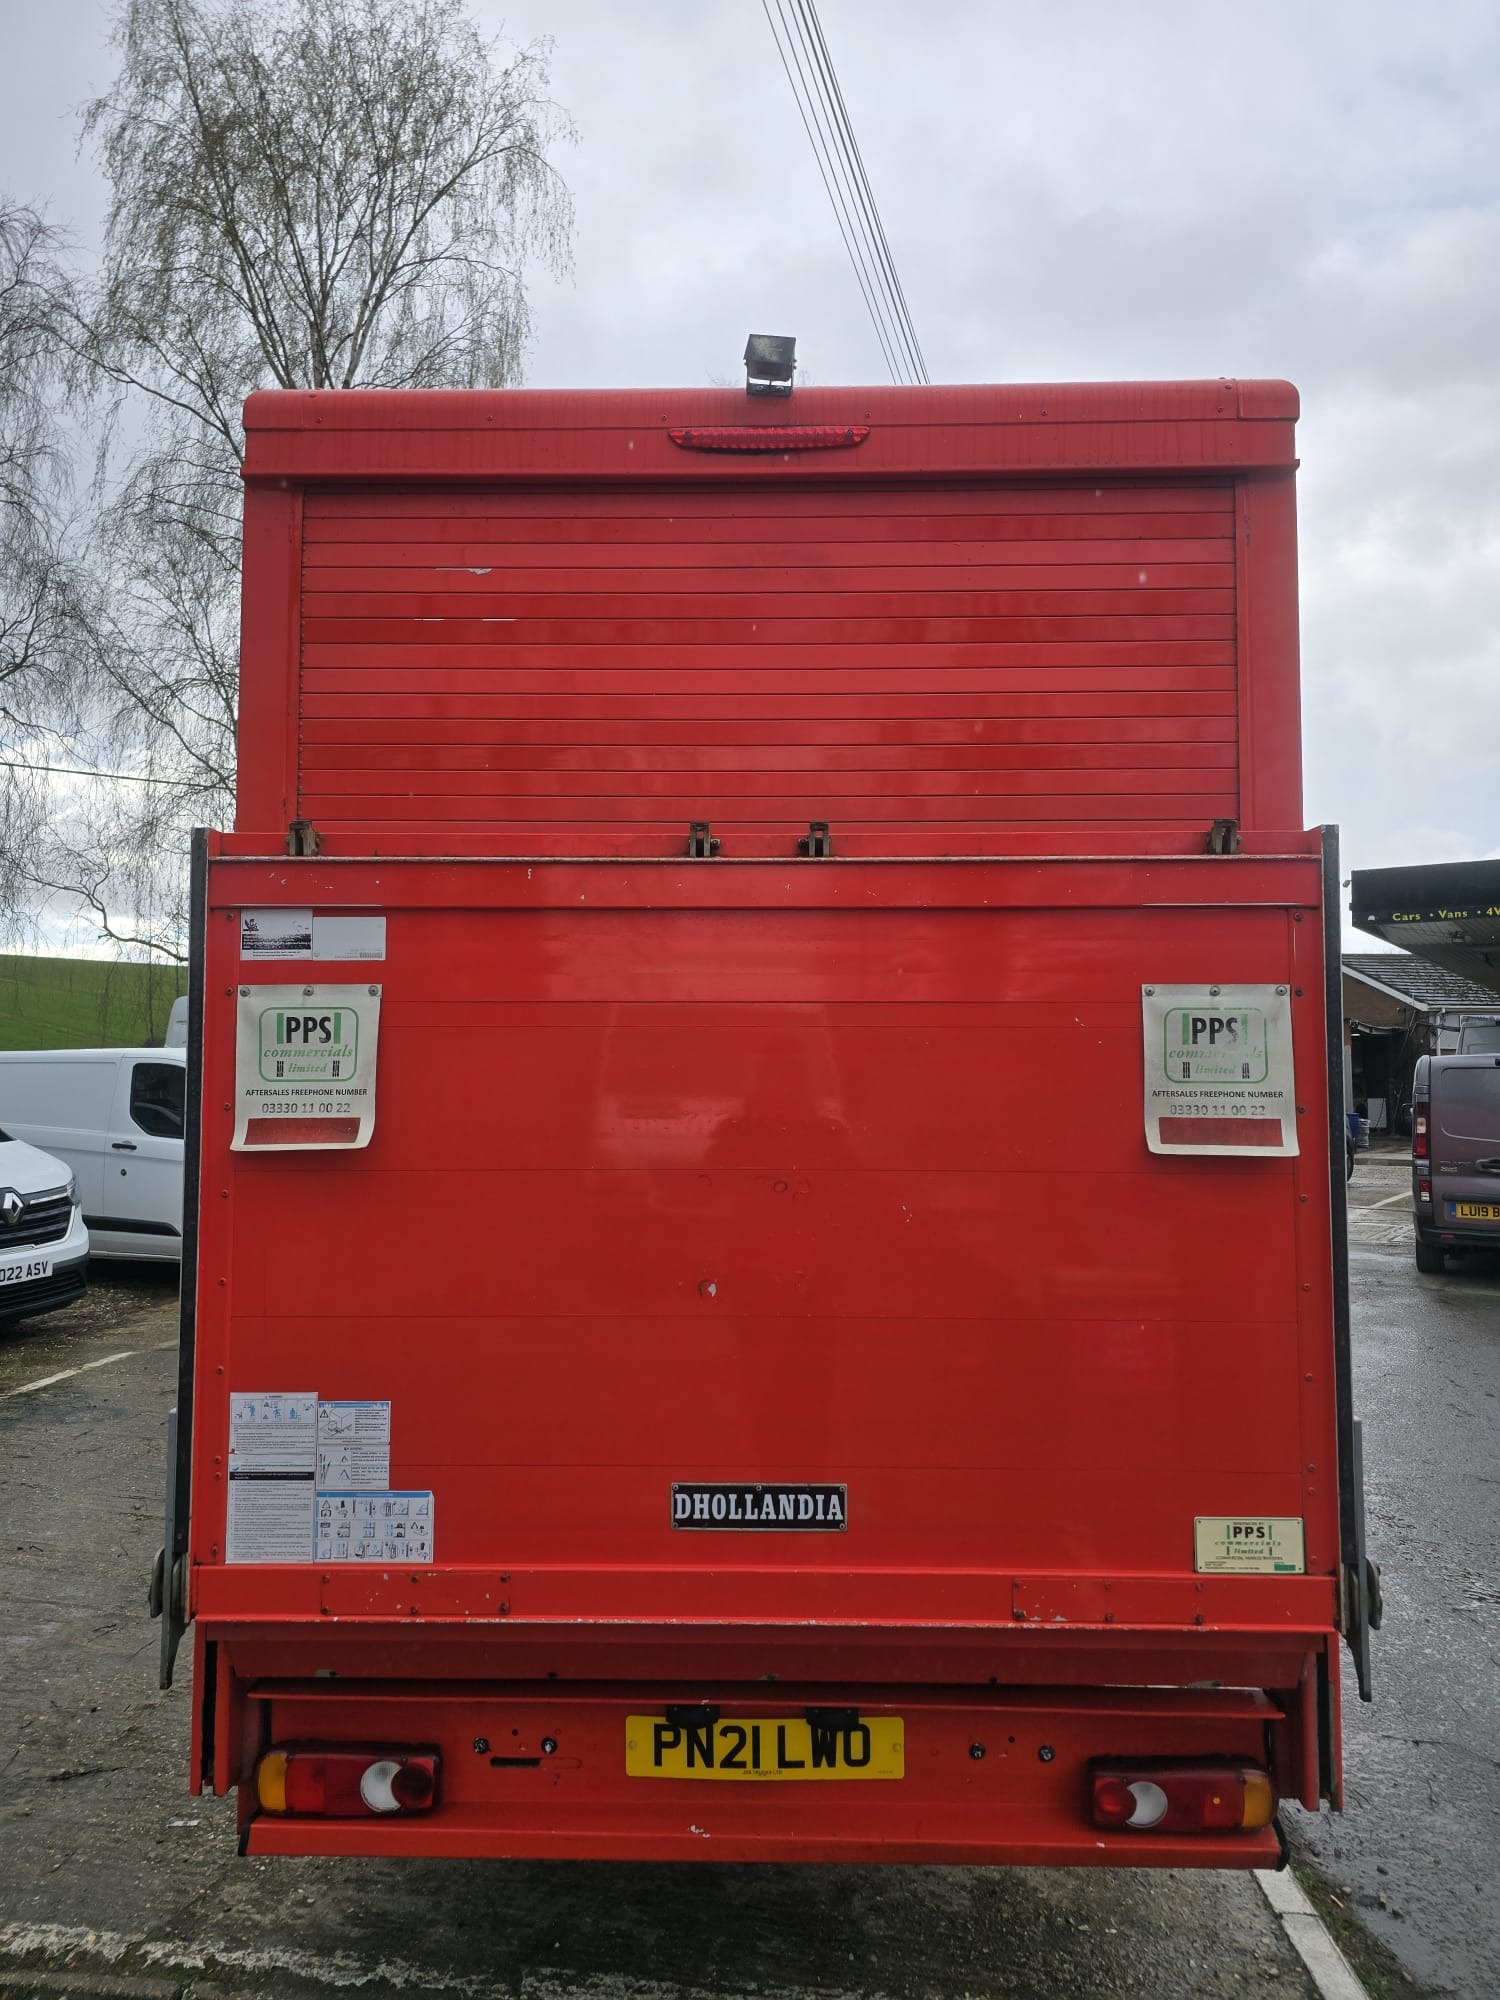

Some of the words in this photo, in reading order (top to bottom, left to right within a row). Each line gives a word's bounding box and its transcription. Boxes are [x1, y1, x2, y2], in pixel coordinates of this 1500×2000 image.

[1392, 912, 1421, 921] Cars
[1438, 909, 1468, 919] Vans
[285, 1016, 332, 1044] PPS
[1191, 1017, 1238, 1045] PPS
[263, 1045, 353, 1058] commercials
[288, 1062, 328, 1074] limited
[1194, 1064, 1236, 1075] limited
[245, 1089, 290, 1097] AFTERSALES
[291, 1089, 334, 1097] FREEPHONE
[335, 1088, 368, 1096] NUMBER
[1151, 1090, 1198, 1098] AFTERSALES
[1199, 1090, 1246, 1098] FREEPHONE
[1247, 1091, 1284, 1099] NUMBER
[261, 1103, 298, 1113] 03330
[301, 1103, 315, 1113] 11
[318, 1103, 333, 1113] 00
[336, 1103, 351, 1113] 22
[1170, 1105, 1209, 1115] 03330
[1212, 1105, 1228, 1115] 11
[1231, 1105, 1246, 1115] 00
[1250, 1105, 1266, 1116] 22
[1460, 1205, 1489, 1216] LU19
[26, 1261, 48, 1278] ASV
[674, 1493, 844, 1521] DHOLLANDIA
[1233, 1526, 1265, 1539] PPS
[653, 1723, 761, 1769] PN21
[777, 1723, 871, 1769] LWO
